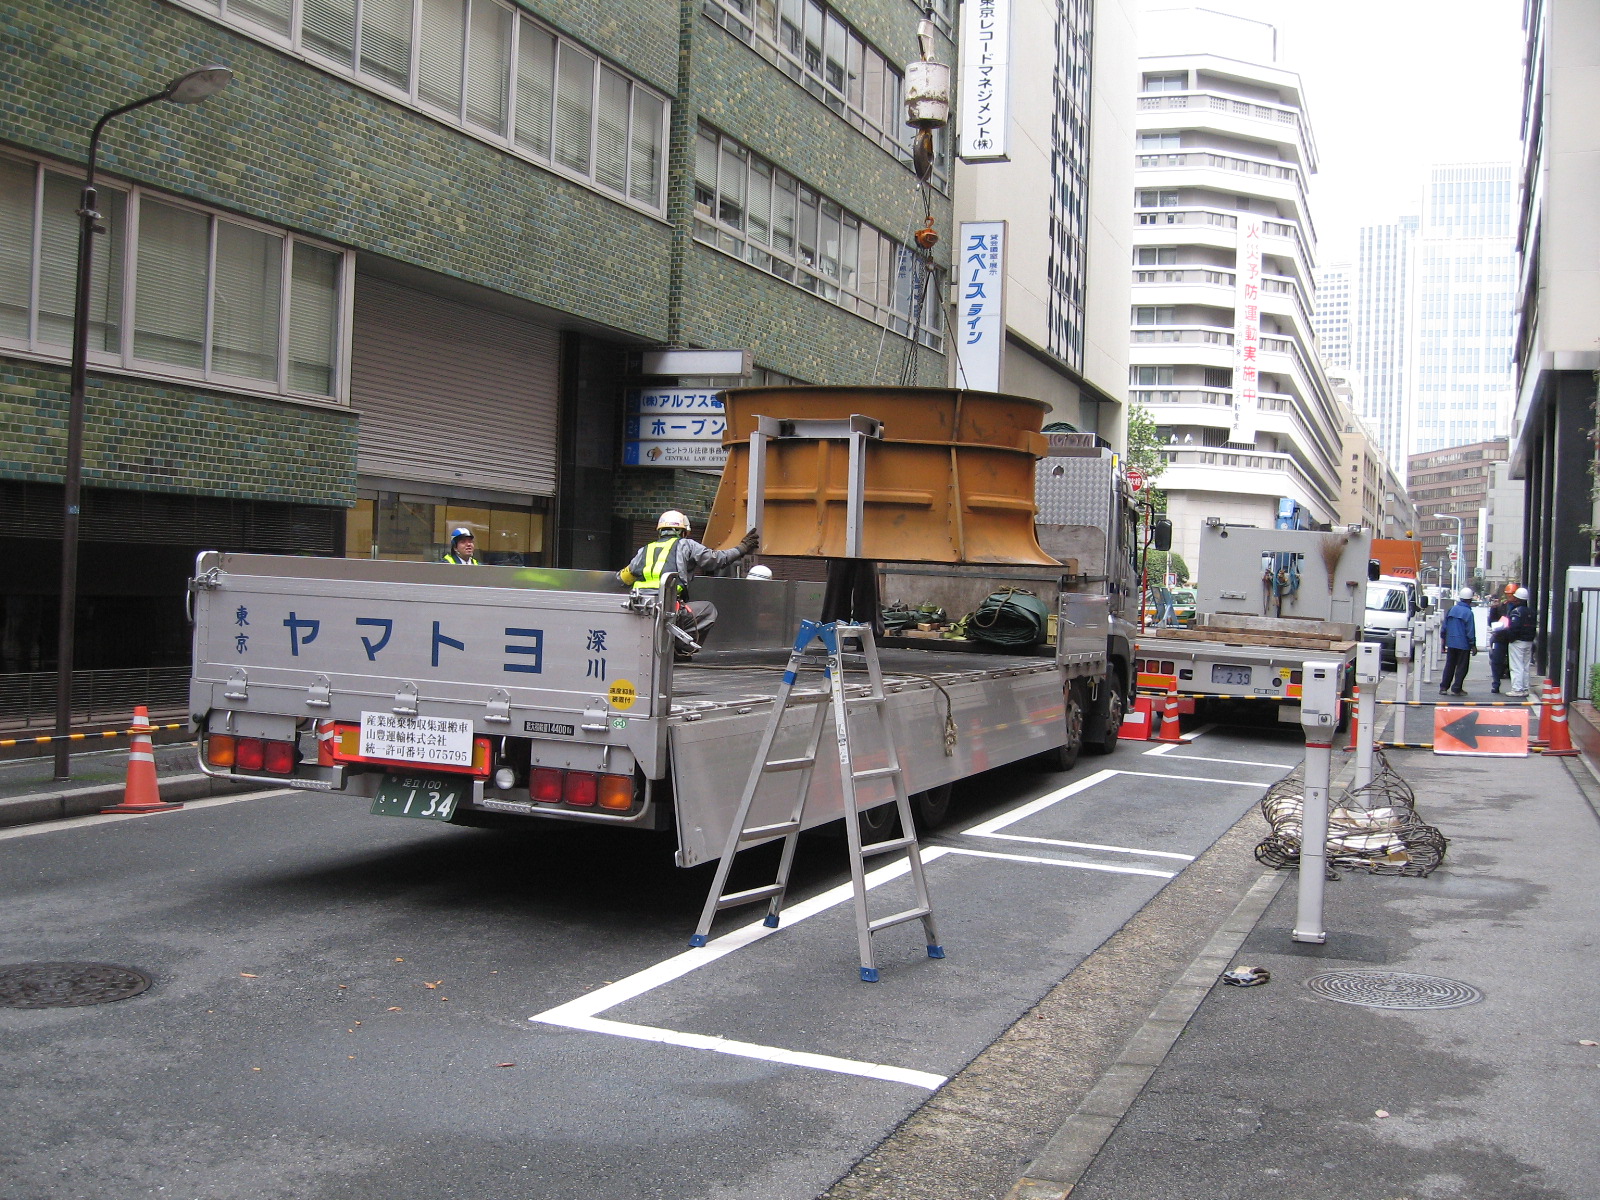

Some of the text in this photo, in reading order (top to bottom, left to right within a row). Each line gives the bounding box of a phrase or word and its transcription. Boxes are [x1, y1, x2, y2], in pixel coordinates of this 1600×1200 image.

[965, 235, 989, 345] スペースライン
[1242, 222, 1259, 403] 火災予防運動実施中
[234, 605, 250, 654] 東京
[283, 611, 544, 674] ヤマトヨ
[586, 628, 608, 682] 深川
[366, 714, 468, 734] 産業廃棄物収集運搬車
[366, 729, 447, 747] 山豊運輸株式会社
[428, 748, 468, 762] 075795
